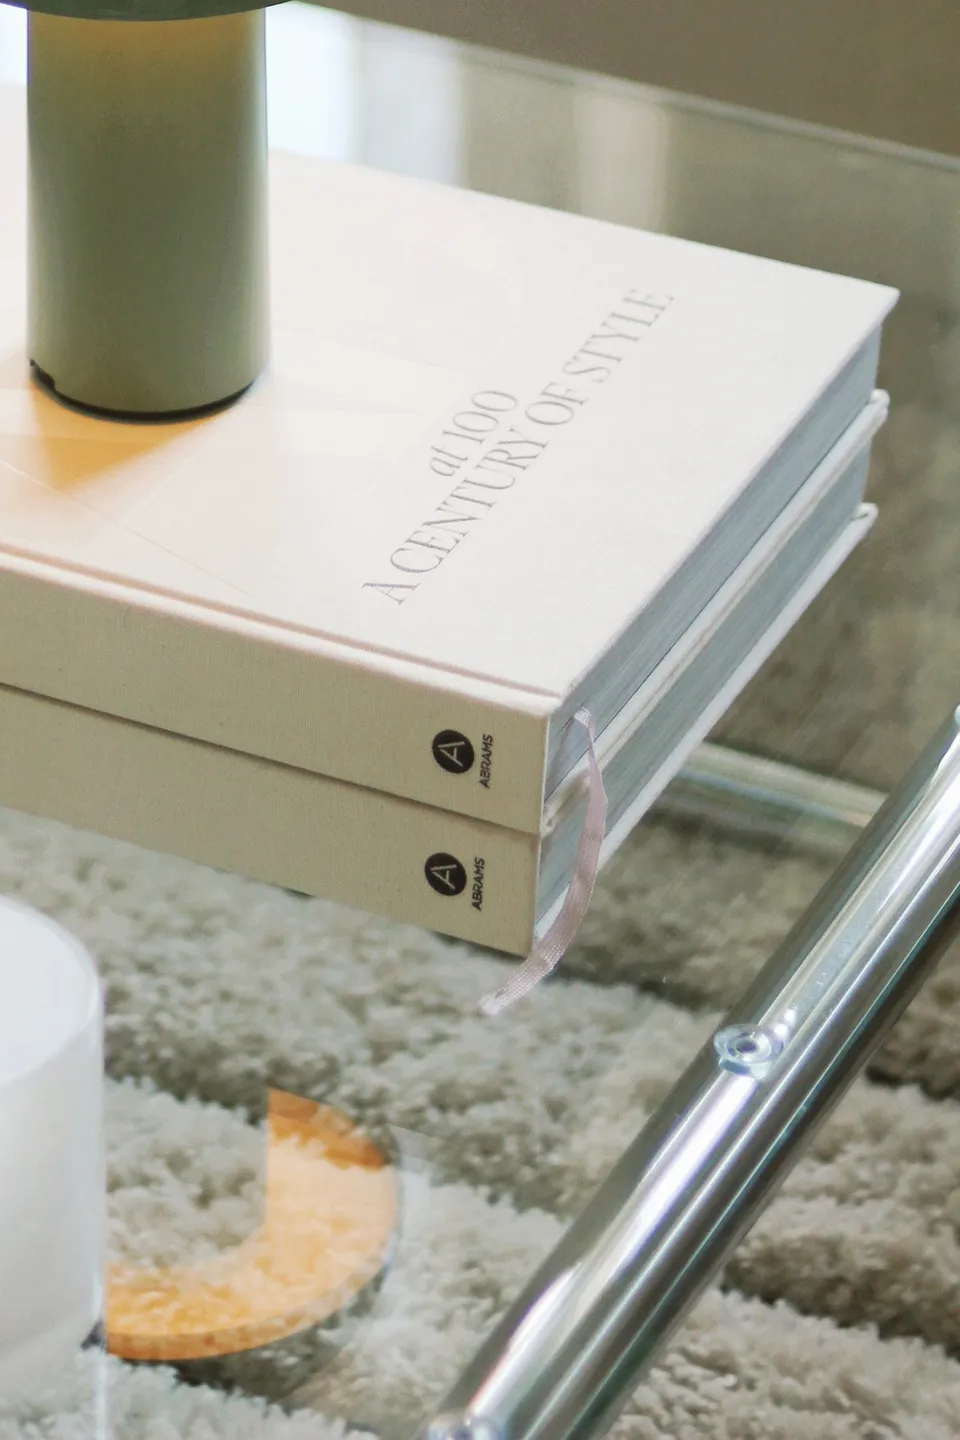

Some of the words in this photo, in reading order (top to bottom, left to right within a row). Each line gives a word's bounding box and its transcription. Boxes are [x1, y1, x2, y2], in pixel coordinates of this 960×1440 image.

[562, 288, 675, 384] STYLE
[443, 390, 518, 443] 100
[524, 382, 589, 426] OF
[429, 446, 468, 477] at
[389, 428, 550, 574] CENTURY
[362, 580, 420, 606] A
[479, 733, 494, 789] ABRAMS
[471, 857, 486, 911] ABRAMS
